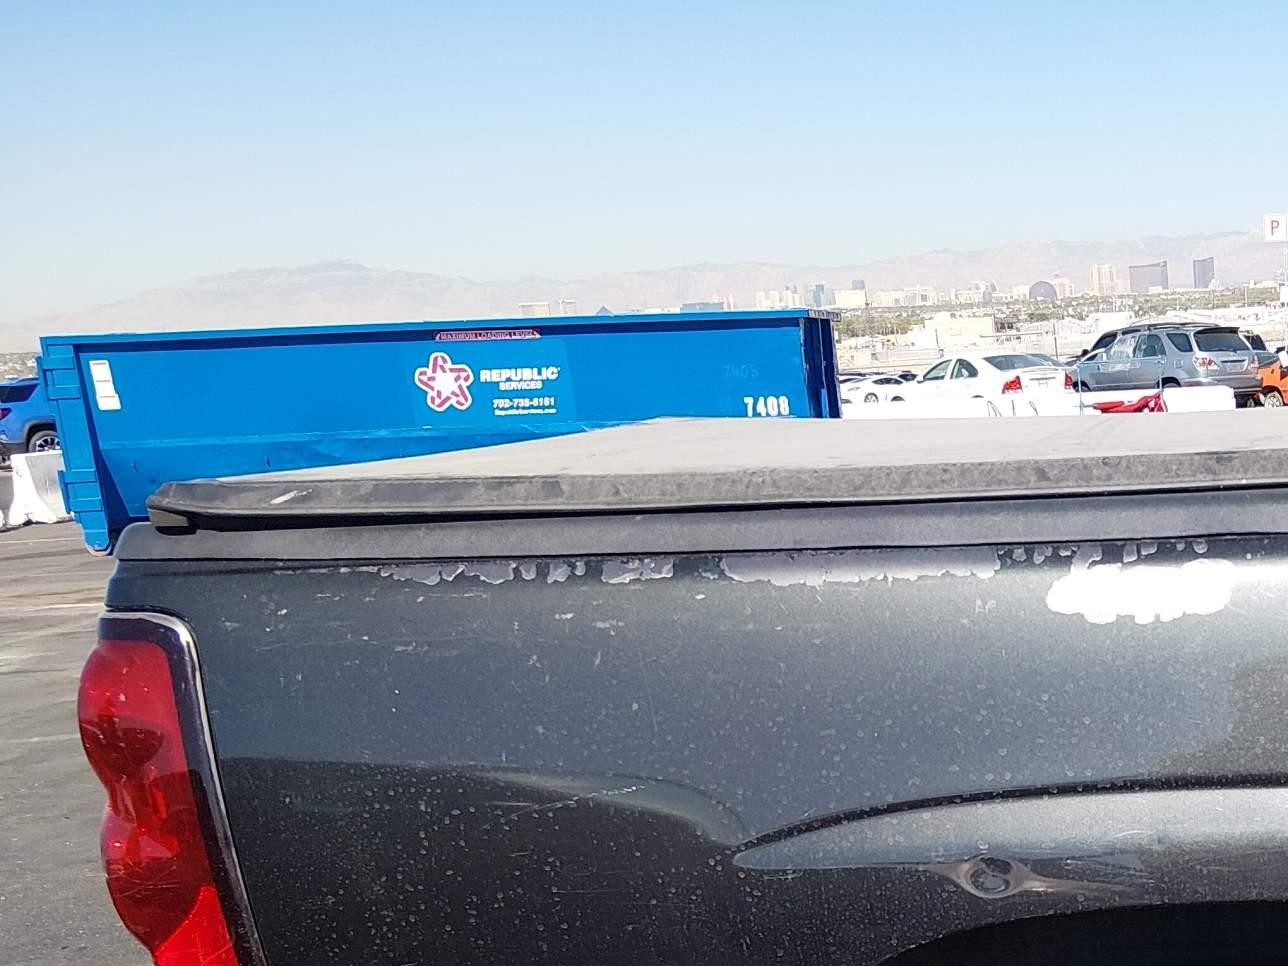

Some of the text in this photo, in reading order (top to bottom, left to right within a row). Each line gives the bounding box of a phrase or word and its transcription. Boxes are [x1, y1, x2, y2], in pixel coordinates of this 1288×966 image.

[1270, 219, 1280, 236] P
[479, 366, 560, 382] REPUBLIC
[499, 380, 543, 391] SERVICES
